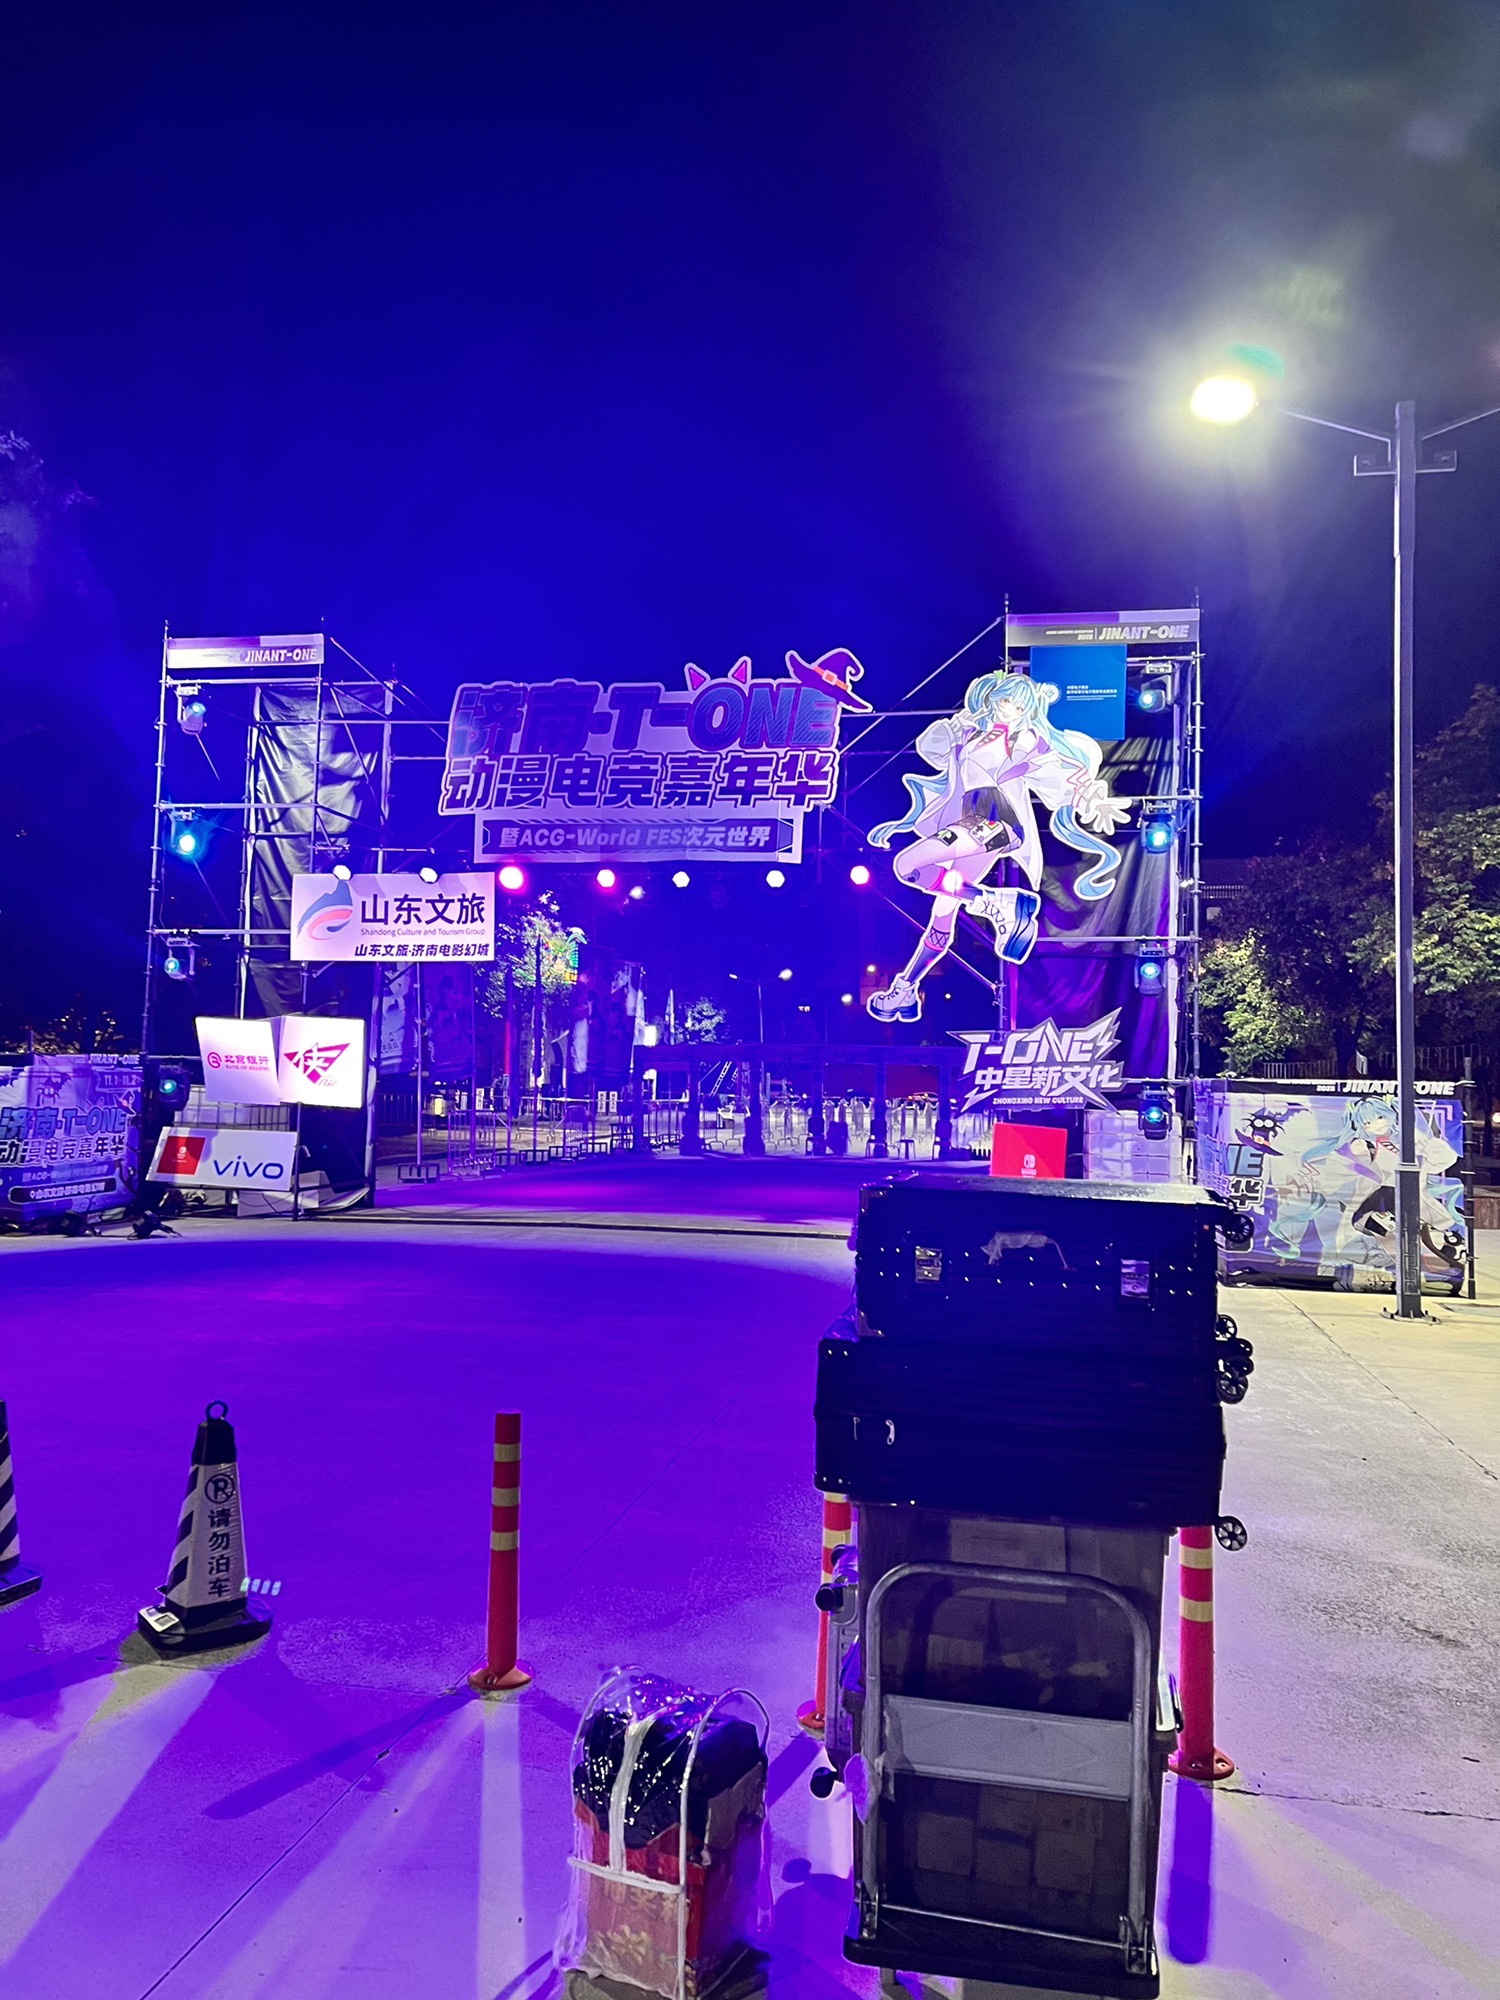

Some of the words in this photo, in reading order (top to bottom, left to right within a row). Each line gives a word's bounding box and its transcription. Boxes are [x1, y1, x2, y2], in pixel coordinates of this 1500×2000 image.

[1098, 625, 1190, 640] JINANT-ONE
[245, 648, 317, 663] JINANT-ONE
[446, 753, 833, 810] 动漫电竞嘉年华
[646, 826, 771, 847] FES次元世界
[361, 893, 485, 925] 山东文旅
[360, 928, 396, 937] Shandong
[397, 928, 422, 936] Culture
[423, 928, 437, 936] and
[438, 928, 465, 936] Tourism
[465, 928, 486, 936] Group
[224, 1055, 269, 1065] 北京银行
[974, 1064, 1123, 1098] 中星新文化
[1052, 1096, 1084, 1104] CULTURE
[213, 1155, 284, 1179] vivo
[207, 1509, 231, 1598] 请勿泊车
